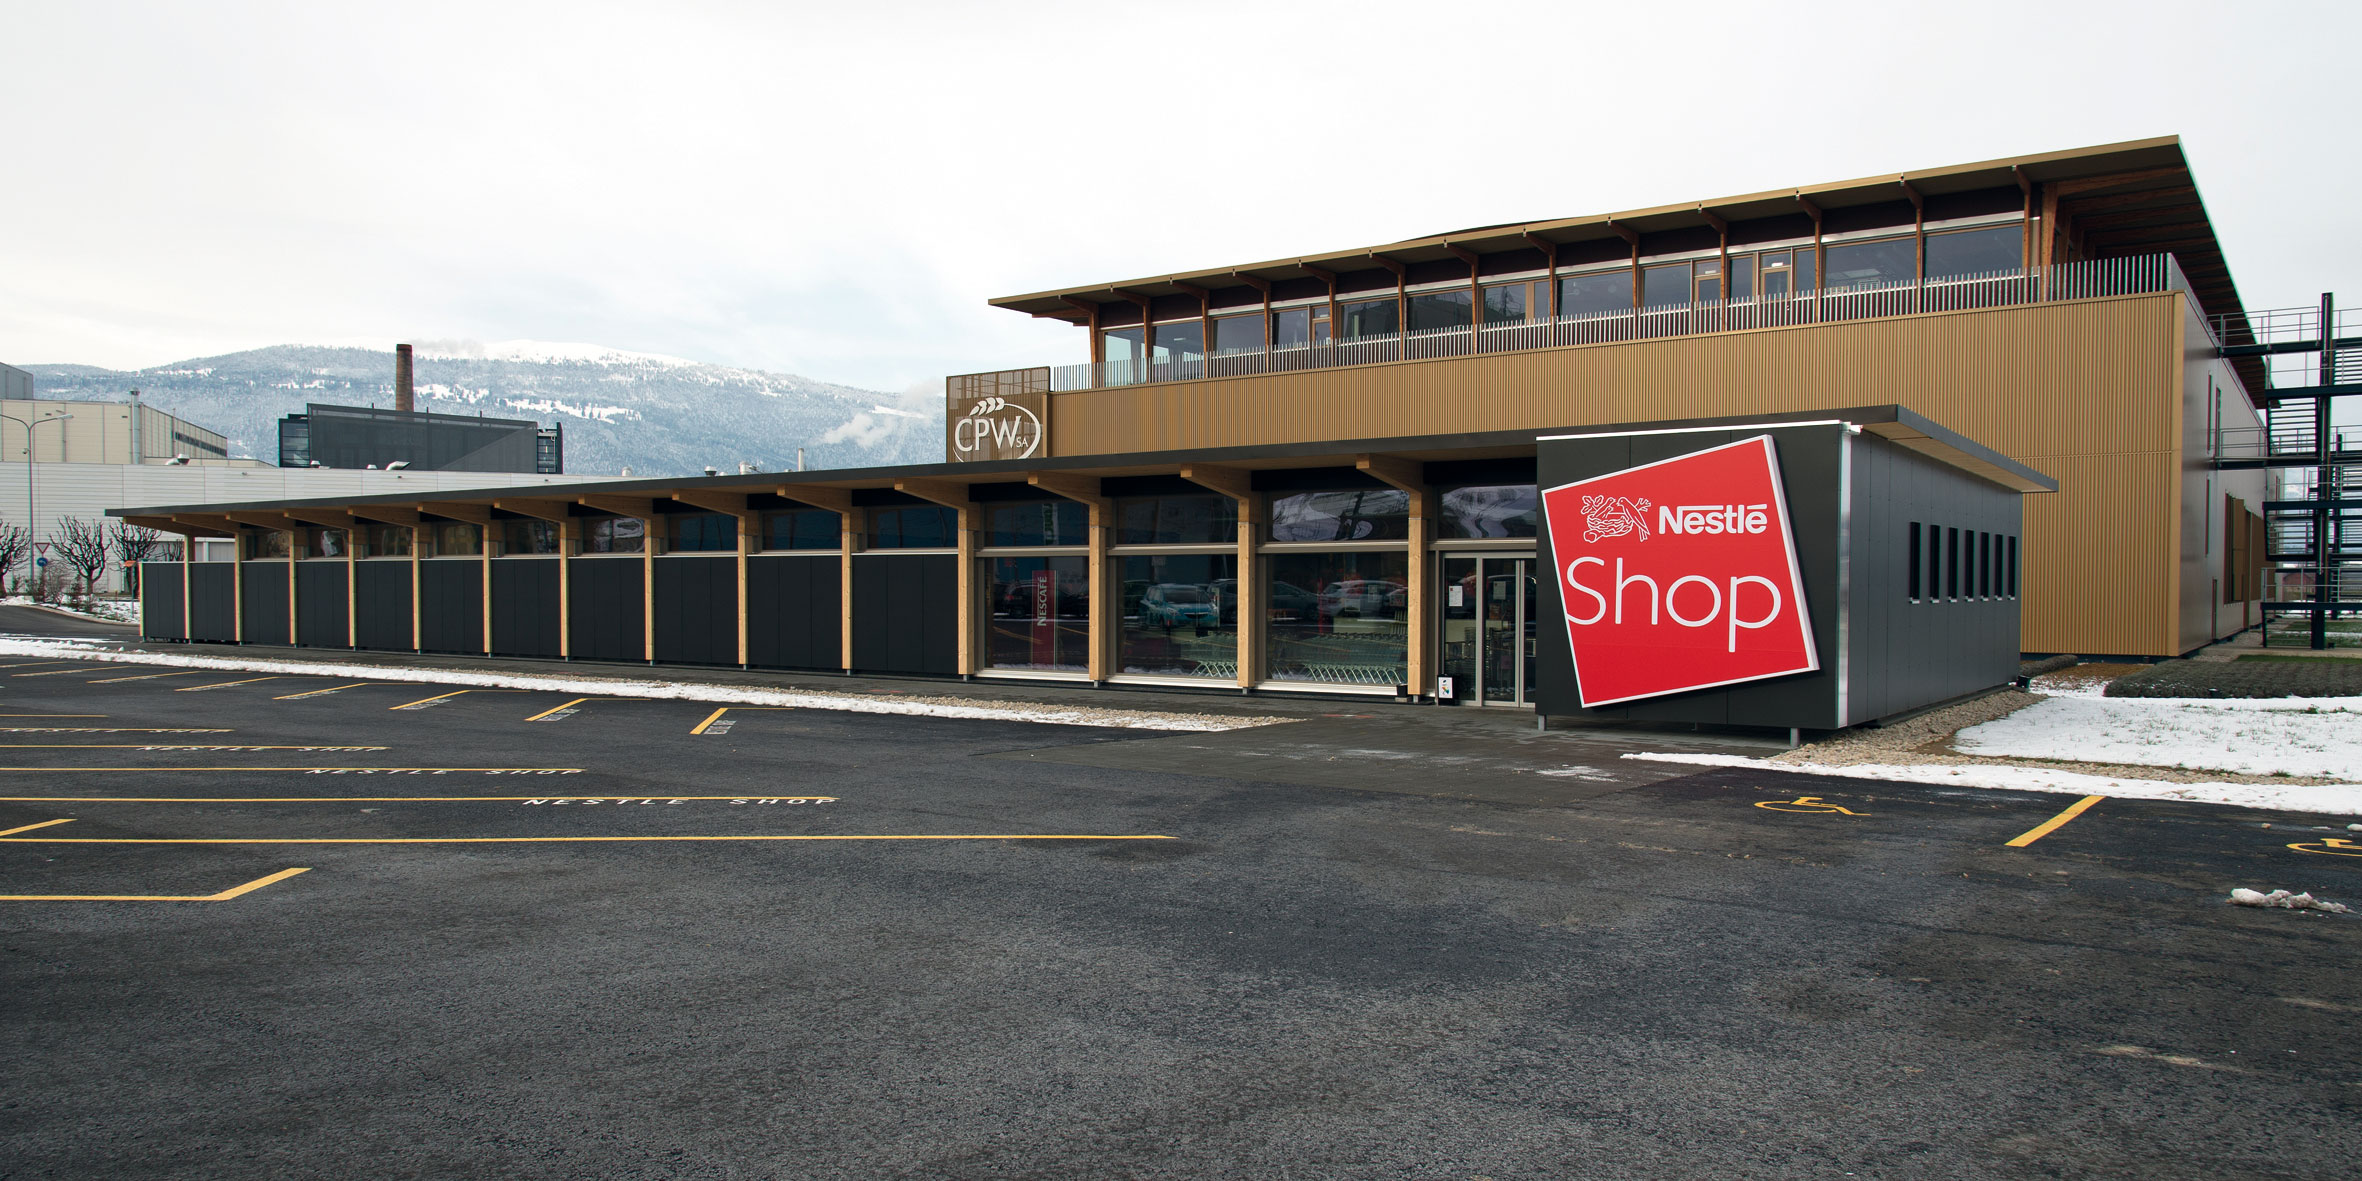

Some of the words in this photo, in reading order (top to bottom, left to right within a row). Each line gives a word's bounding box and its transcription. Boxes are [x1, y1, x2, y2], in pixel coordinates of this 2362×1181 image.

[955, 416, 1021, 452] CPW
[1016, 437, 1029, 448] SA
[1659, 503, 1767, 534] Nestlé
[1037, 576, 1048, 627] NESCAFÉ
[1566, 556, 1781, 653] Shop
